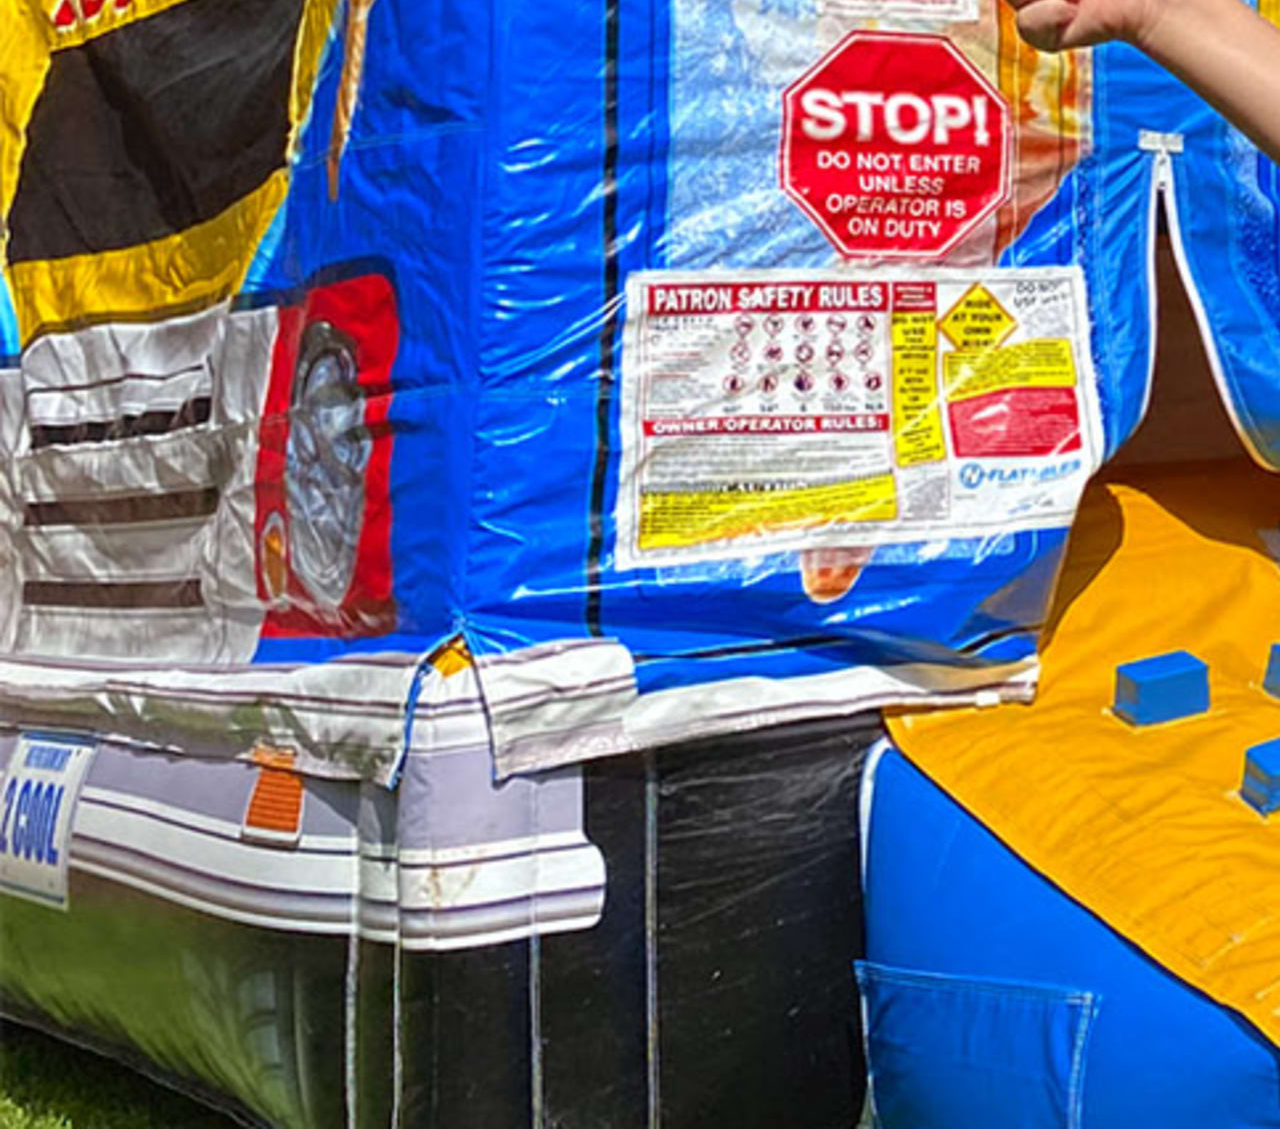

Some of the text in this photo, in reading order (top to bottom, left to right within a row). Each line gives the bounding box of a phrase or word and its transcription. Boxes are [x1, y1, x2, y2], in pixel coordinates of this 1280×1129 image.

[800, 87, 991, 147] STOP!
[817, 151, 982, 174] DO NOT ENTER
[859, 174, 946, 196] UNLESS
[825, 193, 968, 219] OPERATOR IS
[847, 216, 943, 240] ON DUTY
[654, 287, 733, 311] PATRON
[738, 285, 815, 309] SAFETY
[819, 285, 883, 307] RULES
[819, 413, 884, 431] RULES:
